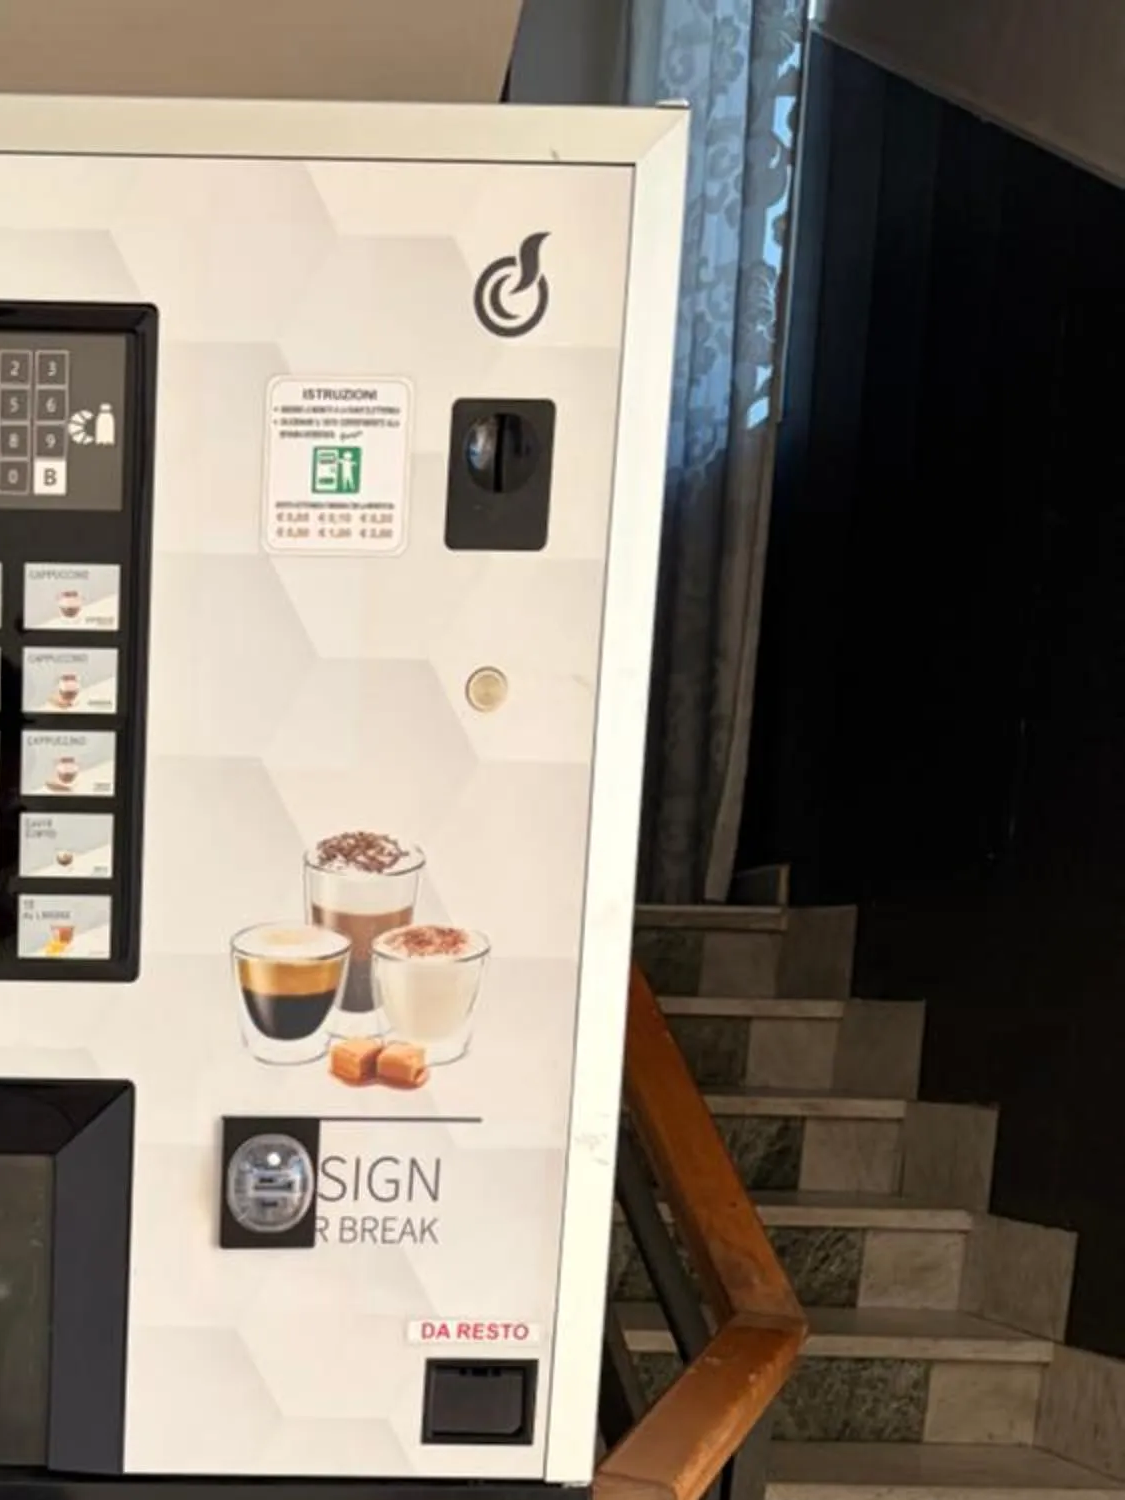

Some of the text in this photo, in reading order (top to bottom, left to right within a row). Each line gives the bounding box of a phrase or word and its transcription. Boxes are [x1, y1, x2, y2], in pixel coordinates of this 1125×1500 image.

[10, 361, 20, 376] 2
[47, 361, 57, 376] 3
[302, 388, 378, 401] ISTRUZIONI
[10, 397, 19, 412] 5
[46, 397, 56, 412] 6
[9, 433, 19, 448] 8
[45, 433, 56, 448] 9
[8, 469, 19, 484] 0
[43, 468, 57, 486] B
[317, 1155, 442, 1203] SIGN
[339, 1217, 439, 1244] BREAK
[422, 1322, 530, 1341] DA RESTO
